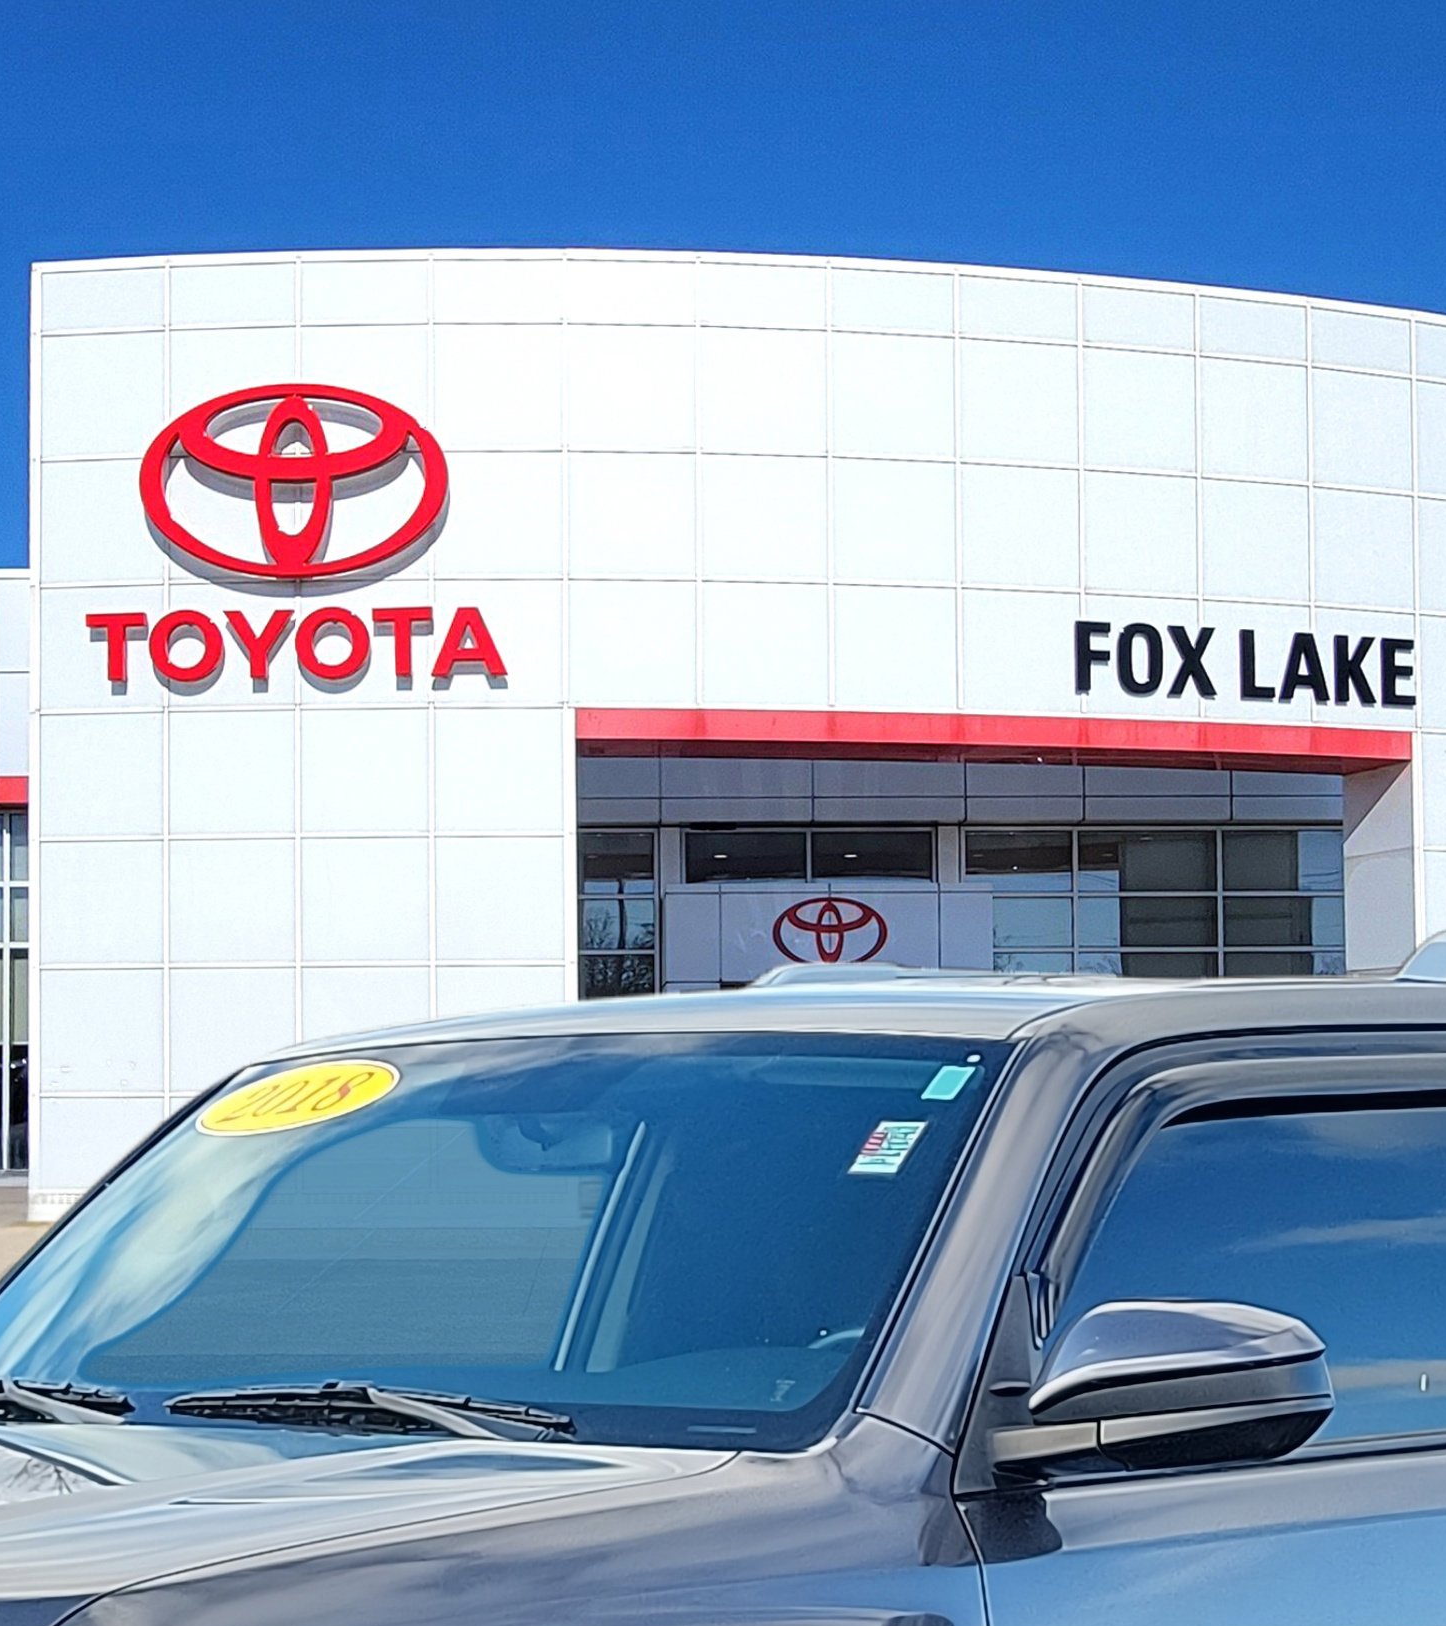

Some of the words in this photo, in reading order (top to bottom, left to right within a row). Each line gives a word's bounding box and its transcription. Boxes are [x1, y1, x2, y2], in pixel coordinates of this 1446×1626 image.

[86, 606, 508, 694] TOYOTA
[1074, 620, 1217, 700] FOX
[1239, 629, 1417, 707] LAKE
[214, 1071, 376, 1124] 2018
